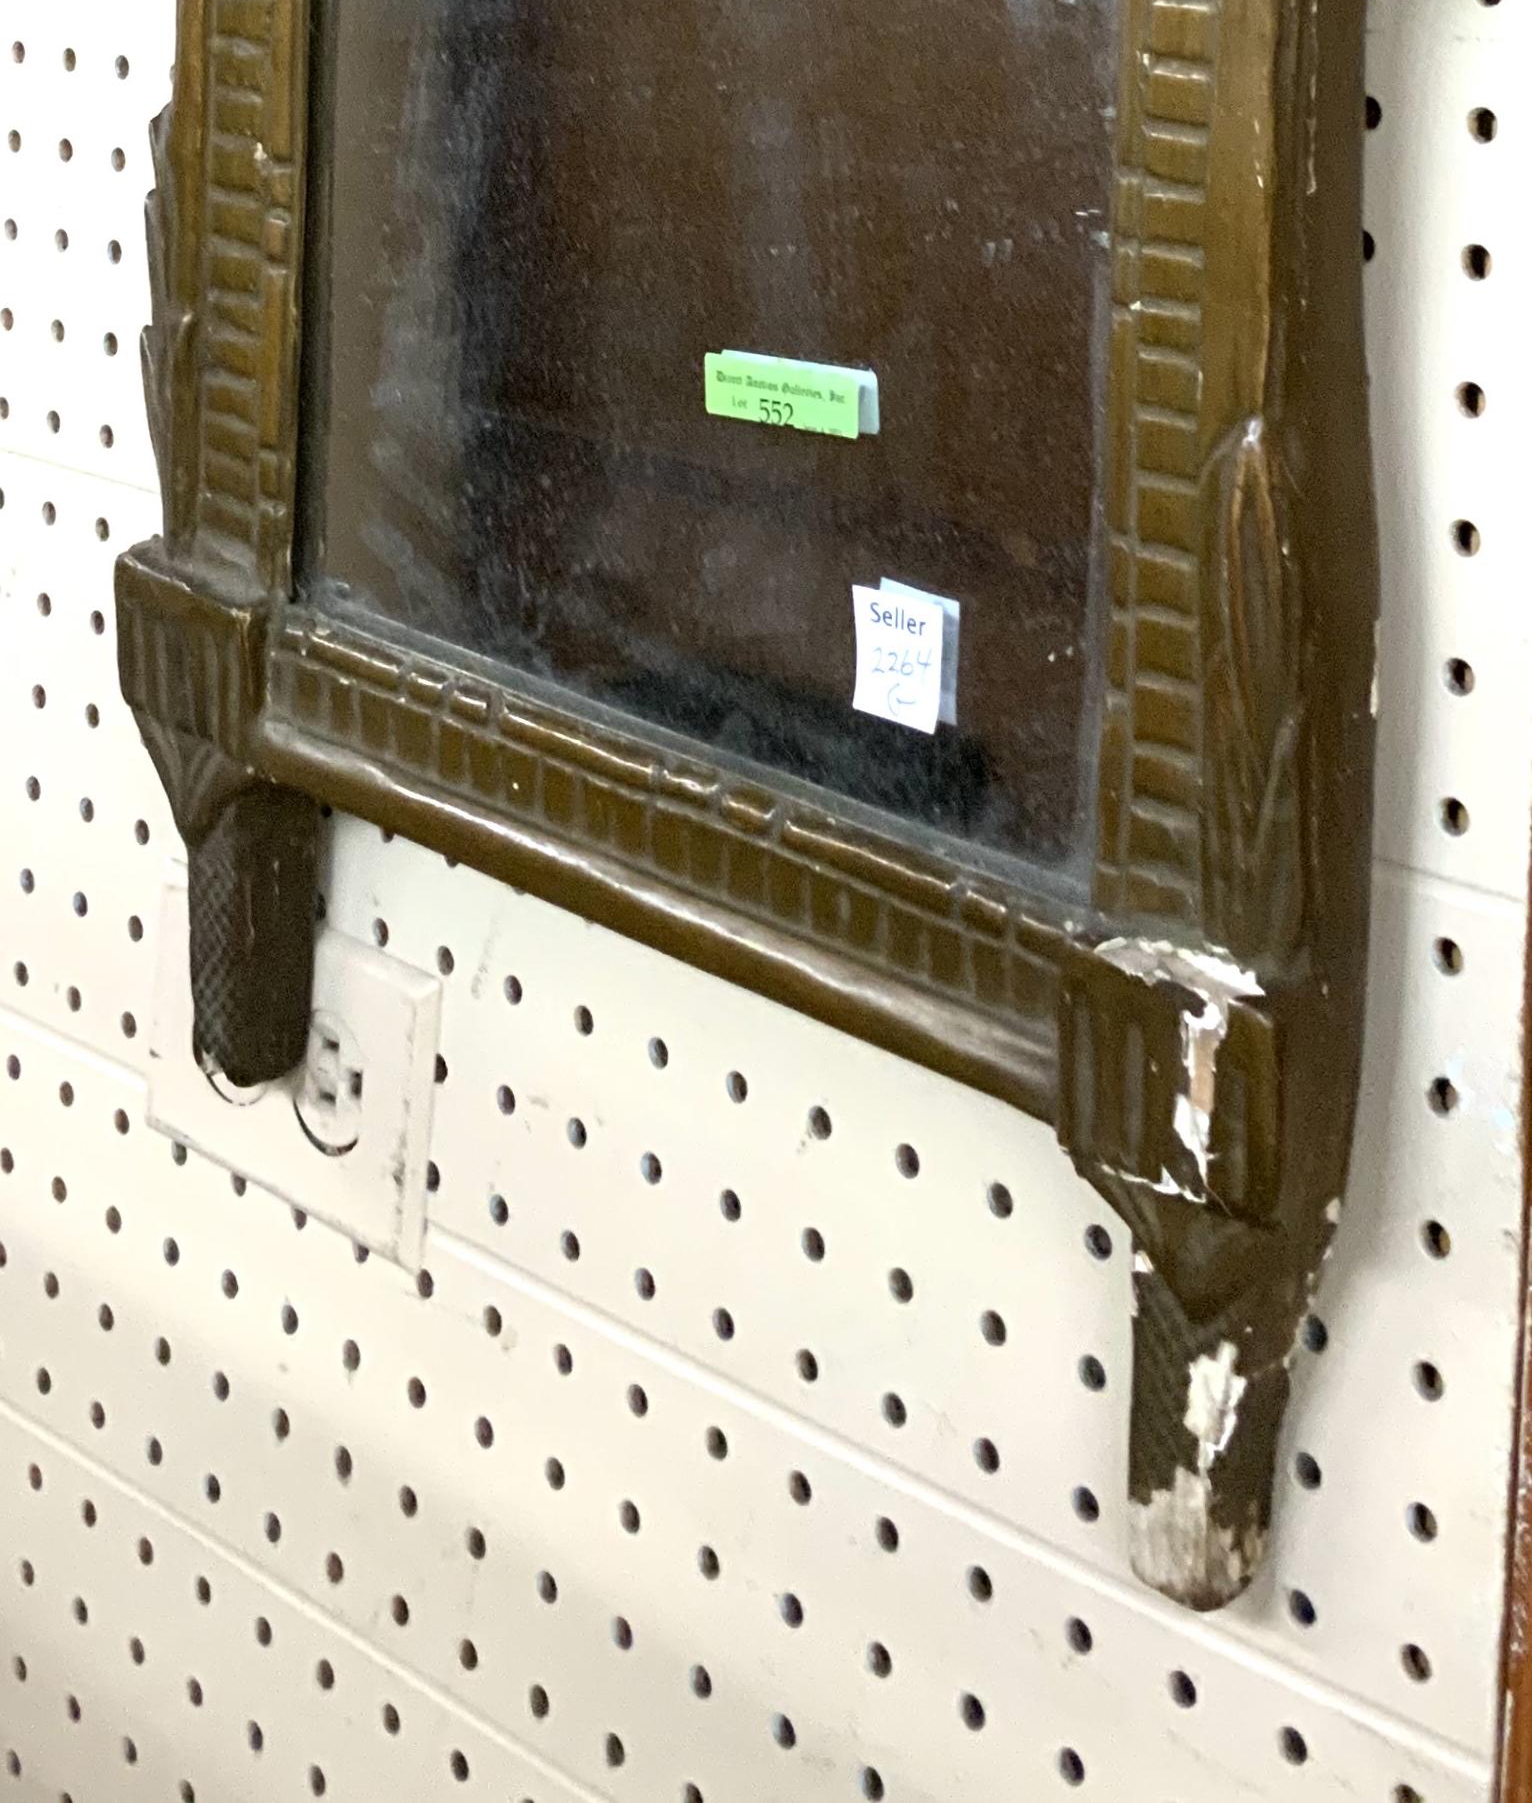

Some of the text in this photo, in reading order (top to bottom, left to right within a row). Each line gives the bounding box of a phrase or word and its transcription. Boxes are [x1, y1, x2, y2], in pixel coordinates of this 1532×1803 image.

[758, 398, 794, 425] 552
[869, 602, 927, 637] Seller
[871, 647, 933, 686] 2264
